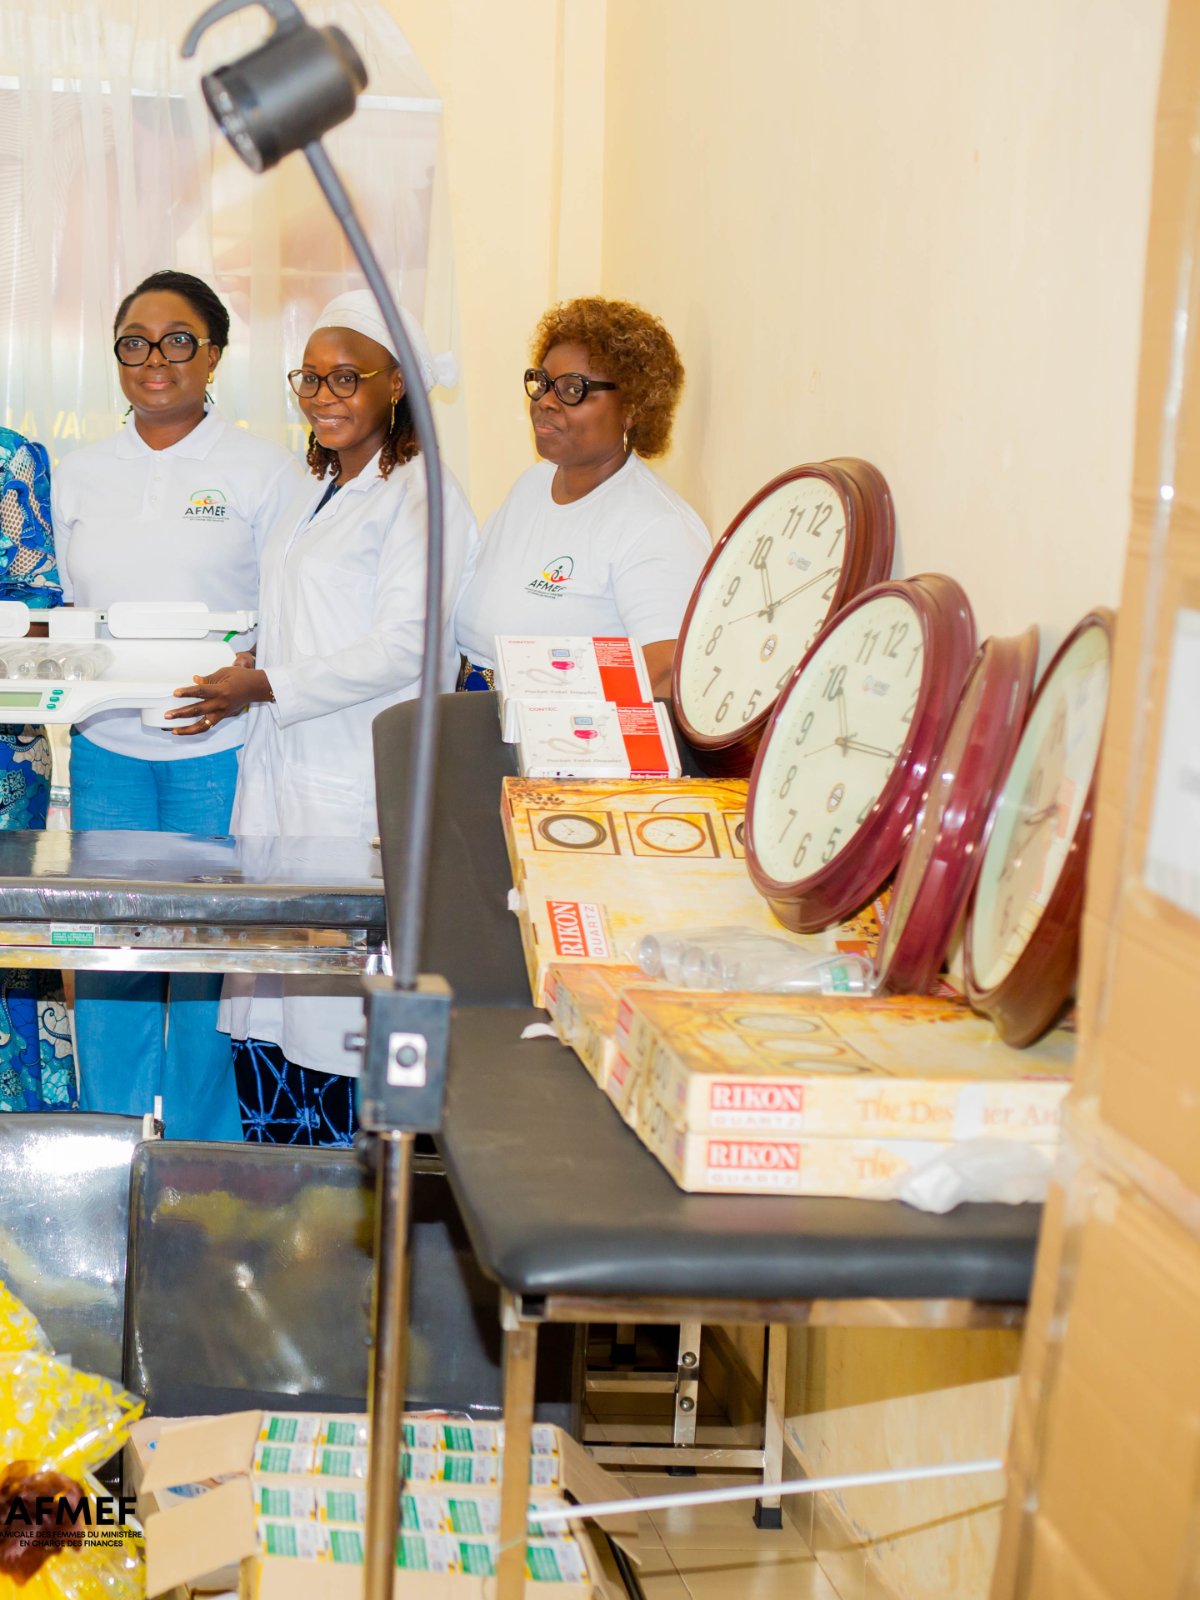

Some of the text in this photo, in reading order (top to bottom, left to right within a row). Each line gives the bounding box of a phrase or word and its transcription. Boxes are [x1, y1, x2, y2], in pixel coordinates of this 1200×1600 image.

[184, 505, 226, 517] AFMEF
[781, 505, 806, 540] 11
[807, 502, 833, 538] 12
[749, 534, 774, 570] 10
[827, 526, 846, 558] 1
[722, 576, 741, 608] 9
[704, 624, 724, 657] 8
[856, 629, 881, 665] 11
[882, 622, 910, 659] 12
[905, 643, 923, 678] 1
[702, 665, 722, 698] 7
[822, 664, 847, 702] 10
[715, 691, 734, 724] 6
[742, 689, 763, 722] 5
[796, 711, 814, 746] 9
[779, 765, 797, 800] 8
[778, 809, 798, 844] 7
[793, 832, 812, 869] 6
[821, 828, 842, 865] 5
[551, 901, 586, 956] RIKON
[584, 905, 604, 955] QUARTZ
[712, 1086, 801, 1110] RIKON
[856, 1089, 899, 1123] The
[709, 1143, 798, 1168] RIKON
